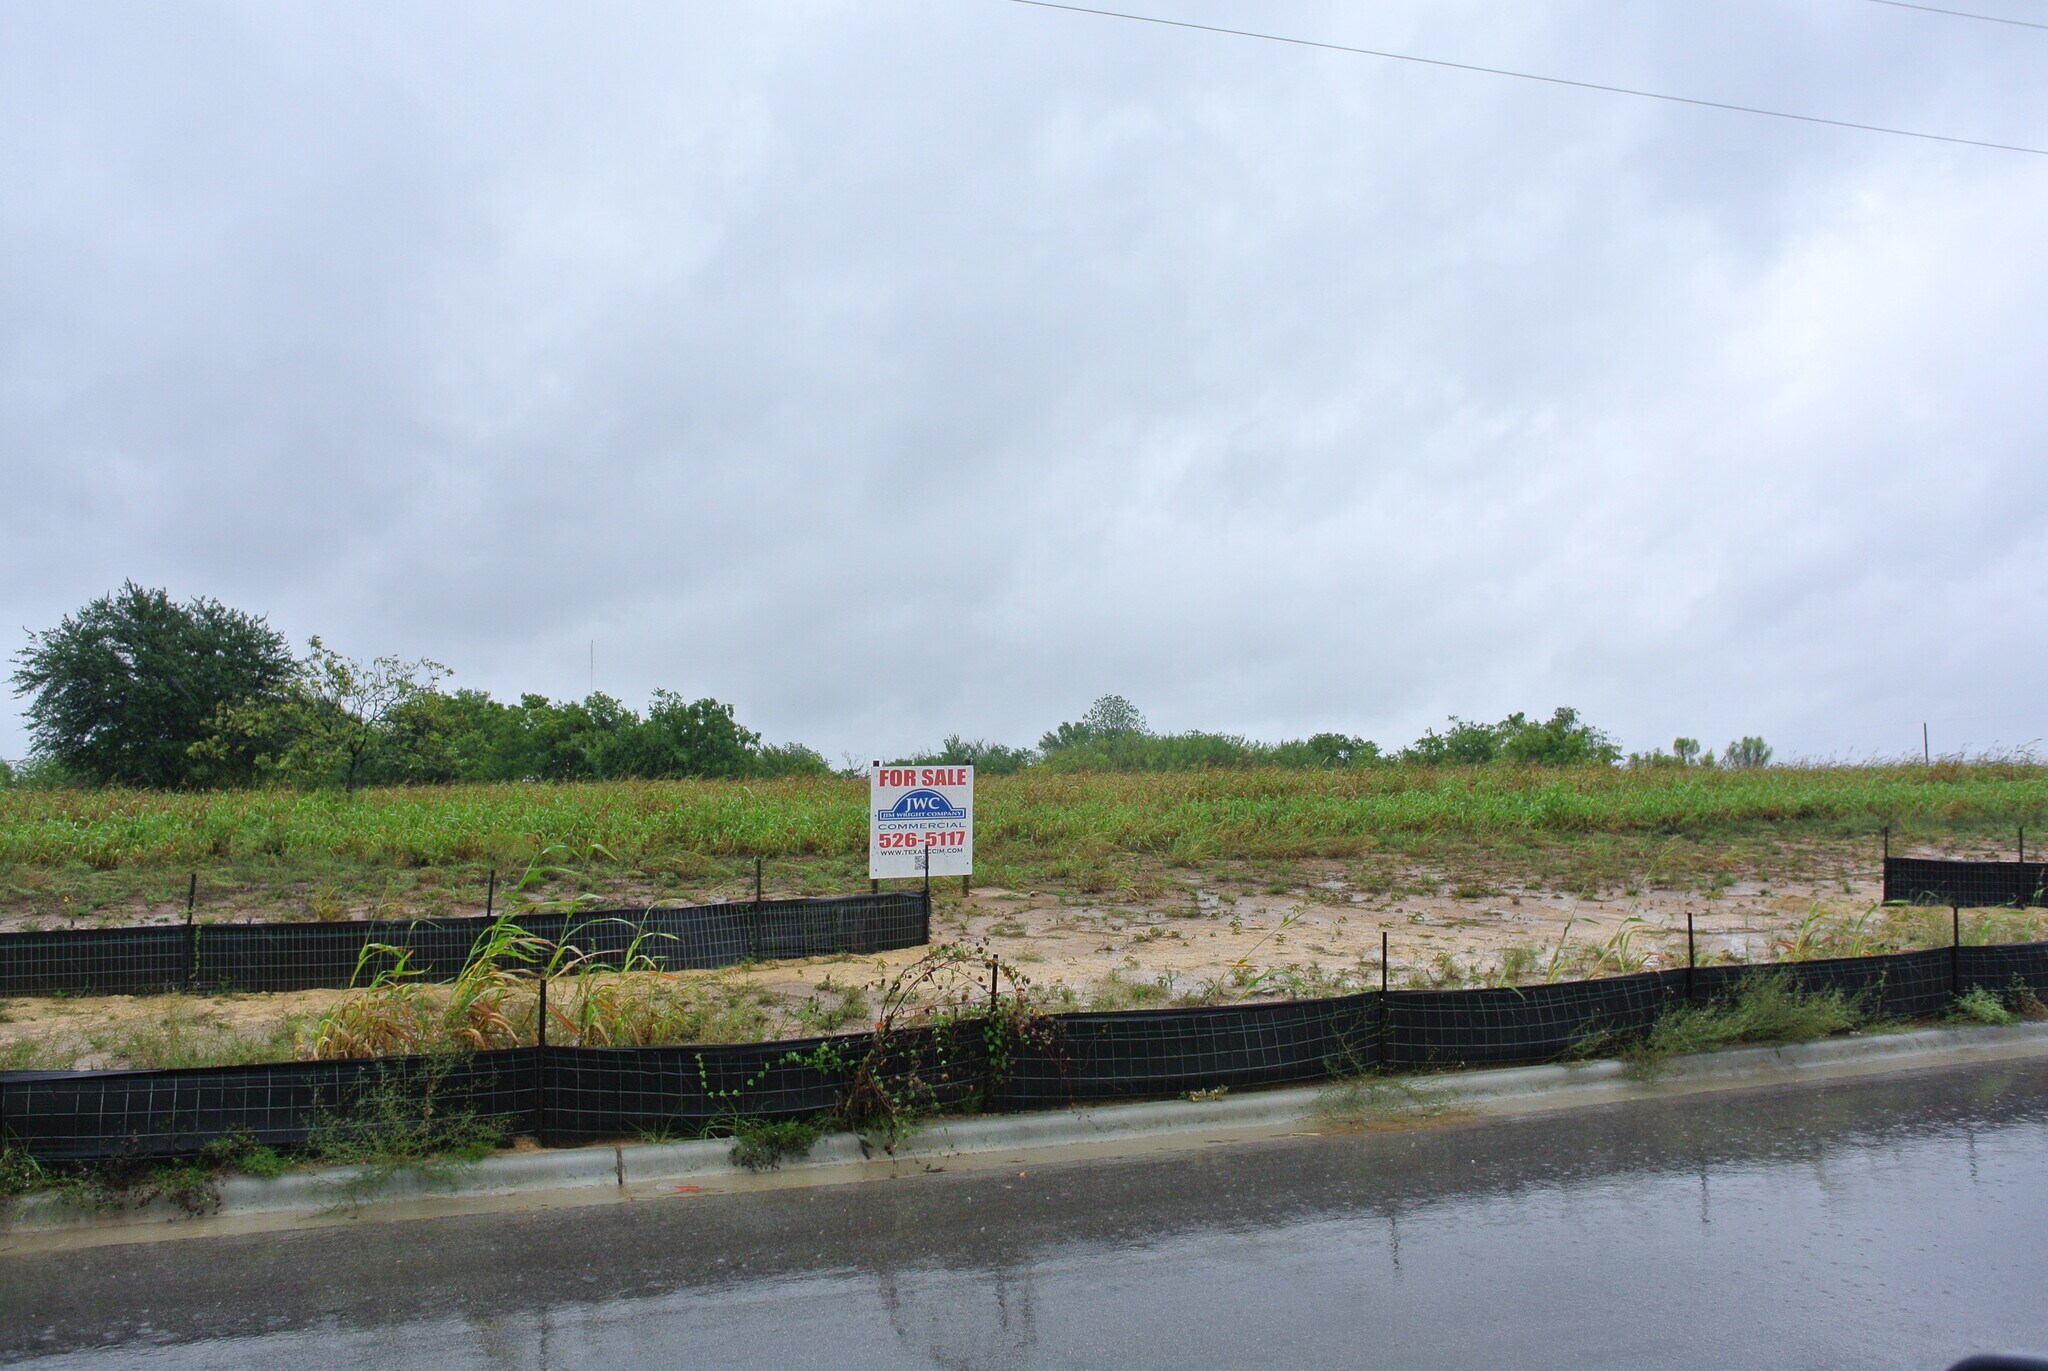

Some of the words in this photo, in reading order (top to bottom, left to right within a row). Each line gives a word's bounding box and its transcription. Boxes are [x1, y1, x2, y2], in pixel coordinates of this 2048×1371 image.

[880, 769, 916, 787] FOR
[922, 769, 966, 786] SALE
[905, 797, 940, 812] JWC
[878, 822, 966, 830] COMMERCIAL
[879, 831, 966, 848] 526-5117
